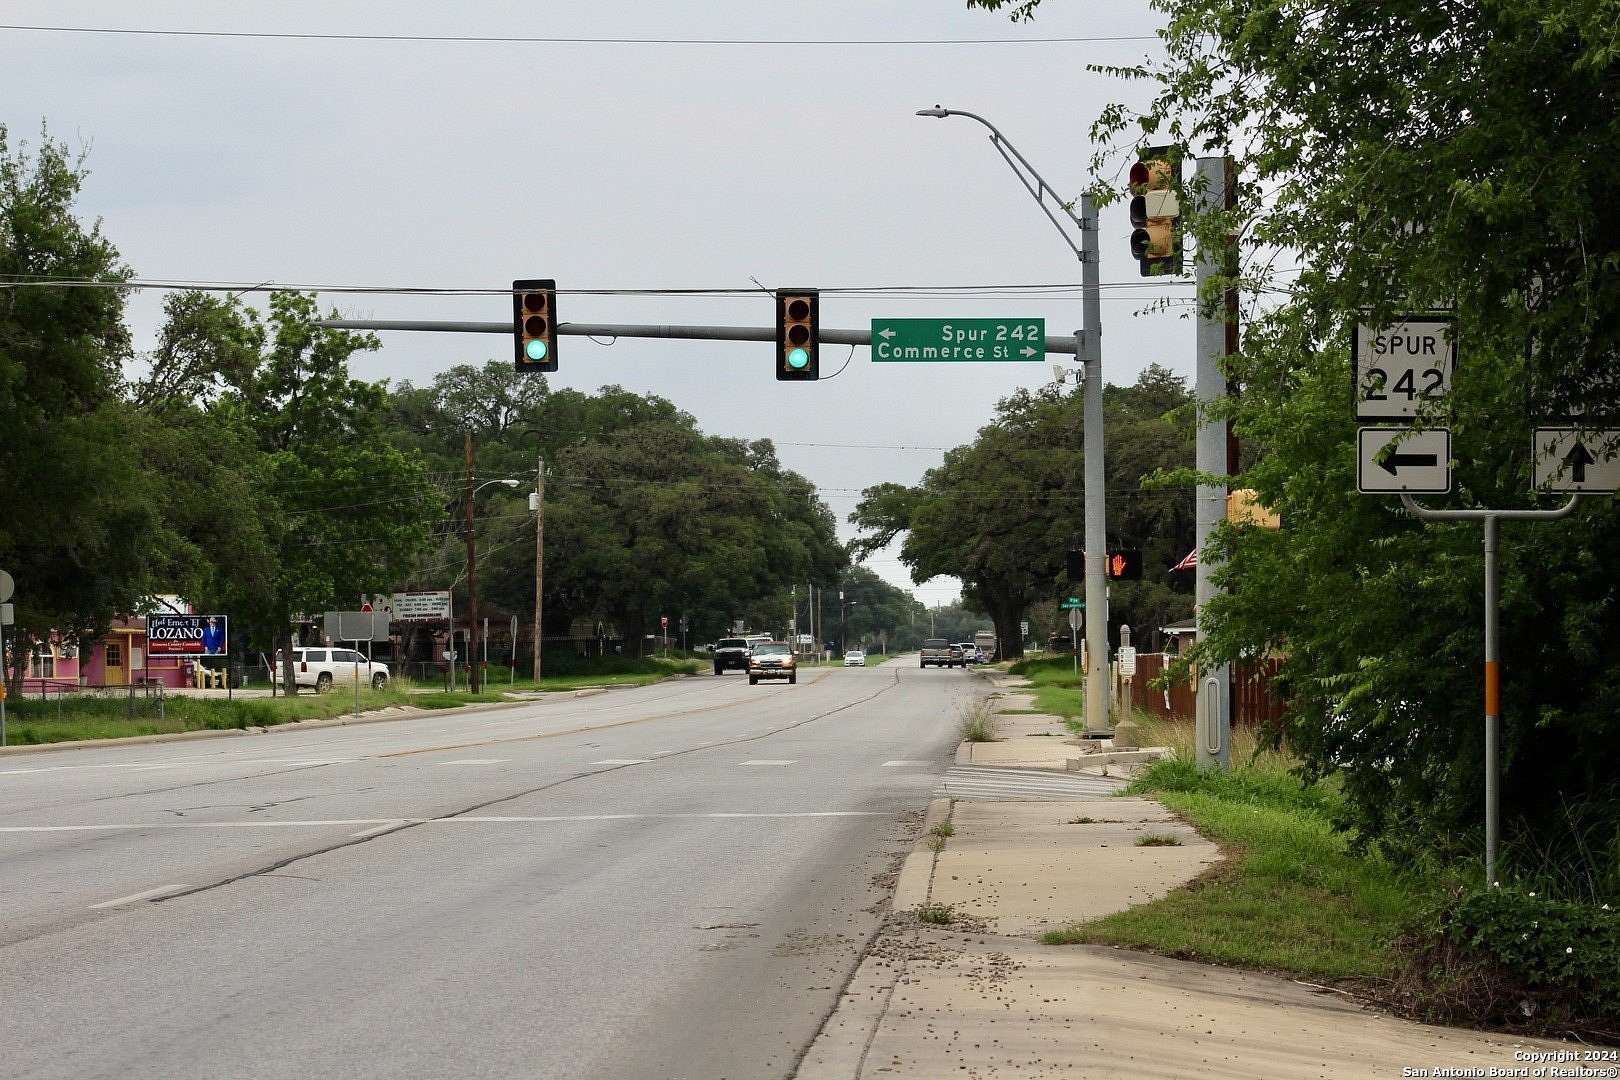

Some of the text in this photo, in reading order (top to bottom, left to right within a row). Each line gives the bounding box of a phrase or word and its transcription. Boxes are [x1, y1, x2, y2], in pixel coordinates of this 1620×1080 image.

[942, 325, 1039, 343] Spur 242
[878, 342, 1009, 358] Commerce St
[1375, 336, 1436, 355] SPUR
[1365, 368, 1444, 401] 242
[150, 627, 204, 639] LOZANO
